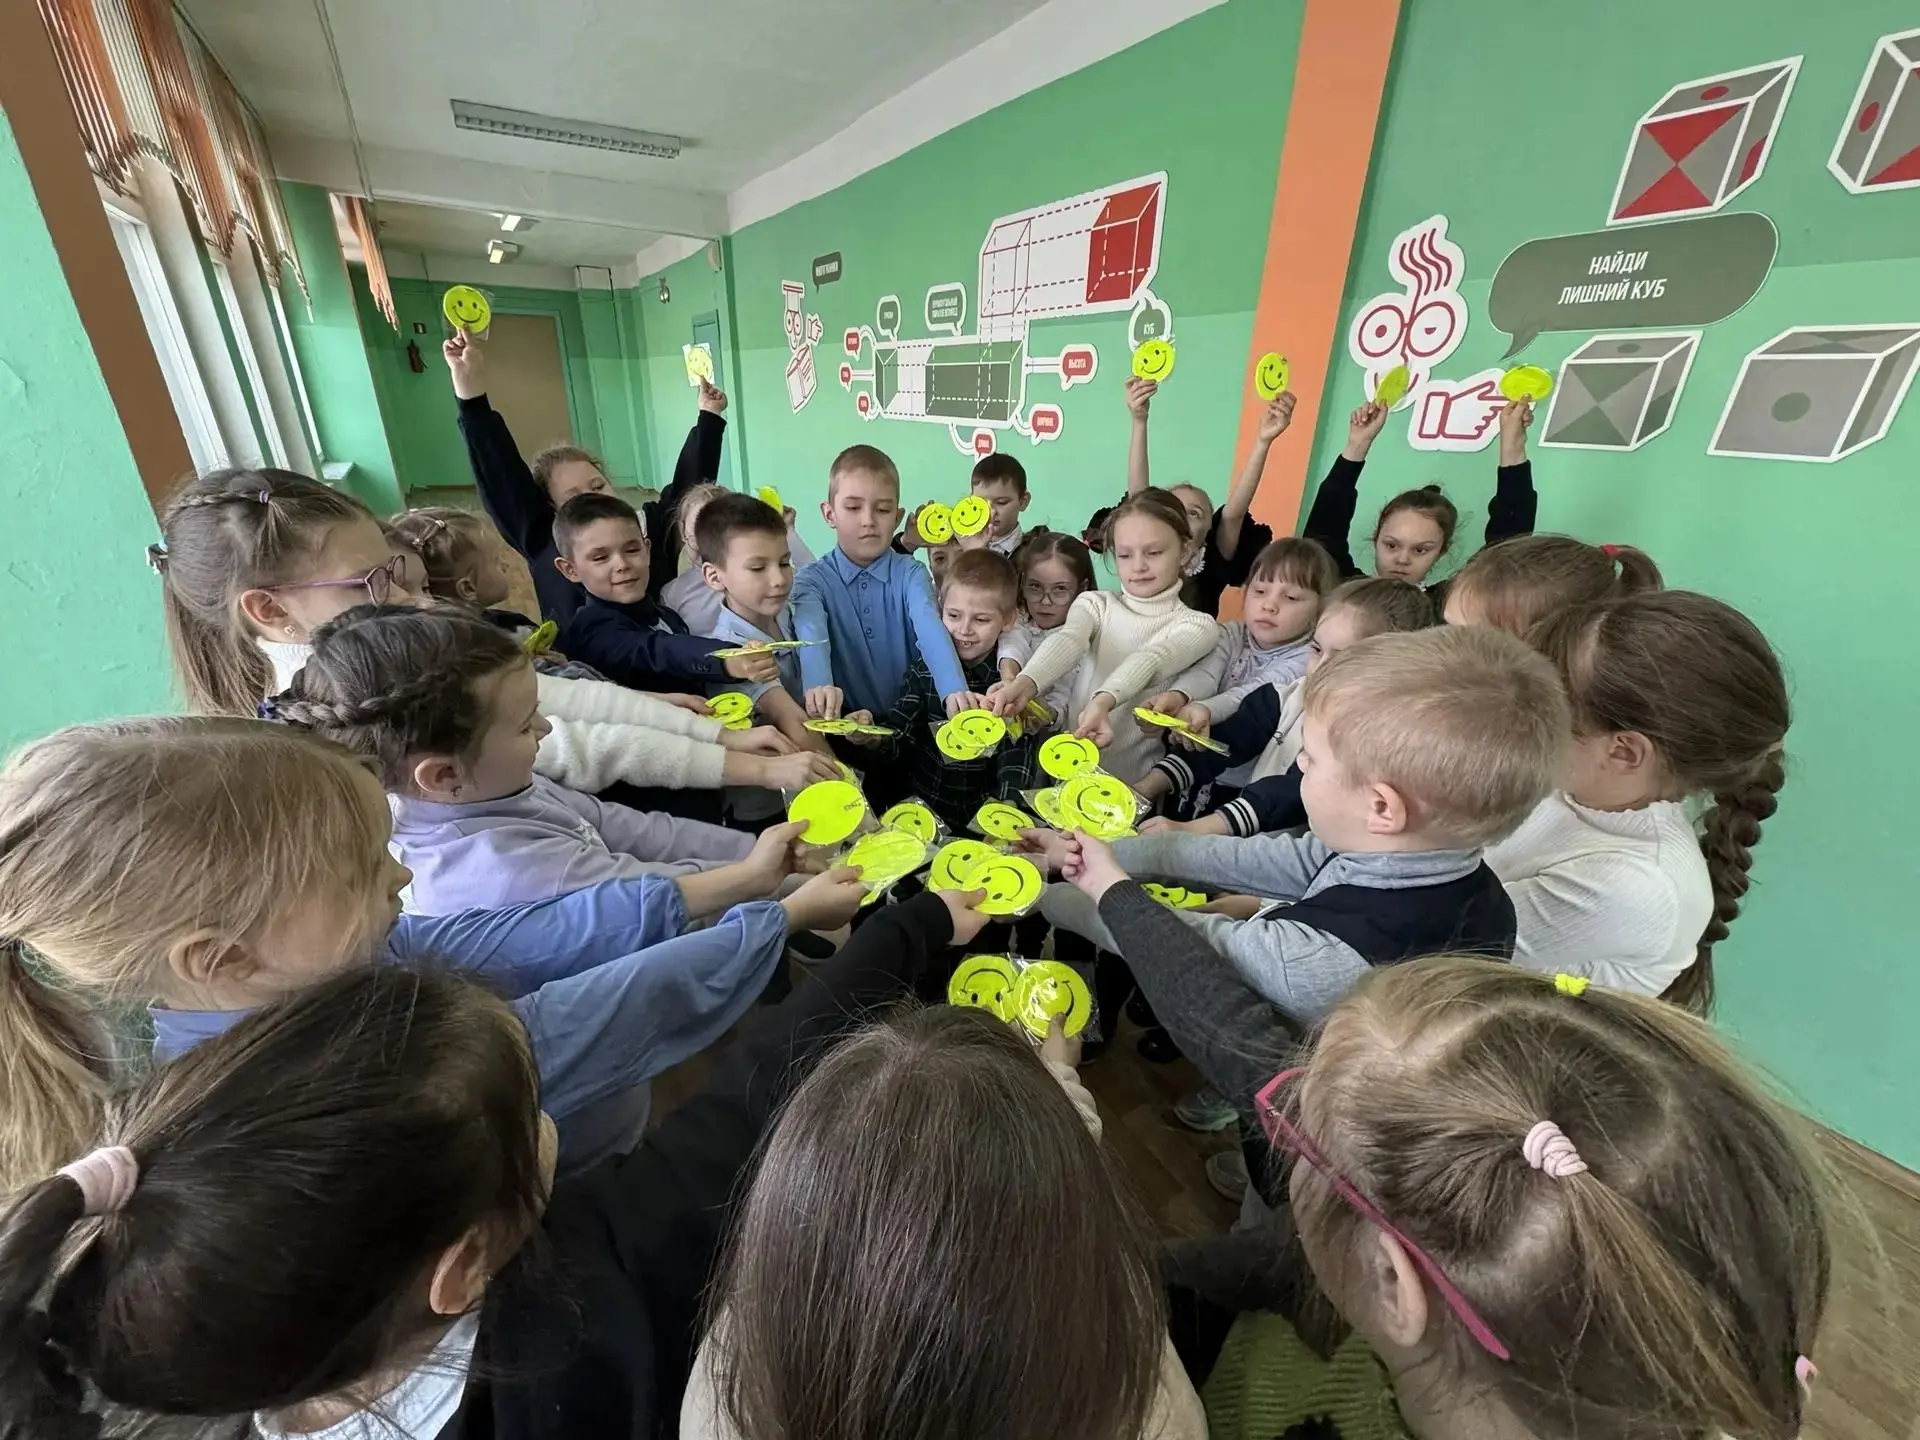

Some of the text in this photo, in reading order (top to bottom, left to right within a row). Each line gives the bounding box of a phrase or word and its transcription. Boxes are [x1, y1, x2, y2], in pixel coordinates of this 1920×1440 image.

[1588, 250, 1649, 275] НАЙДИ
[1557, 278, 1668, 304] ЛИШНИЙ КУБ
[1143, 322, 1155, 335] КУБ
